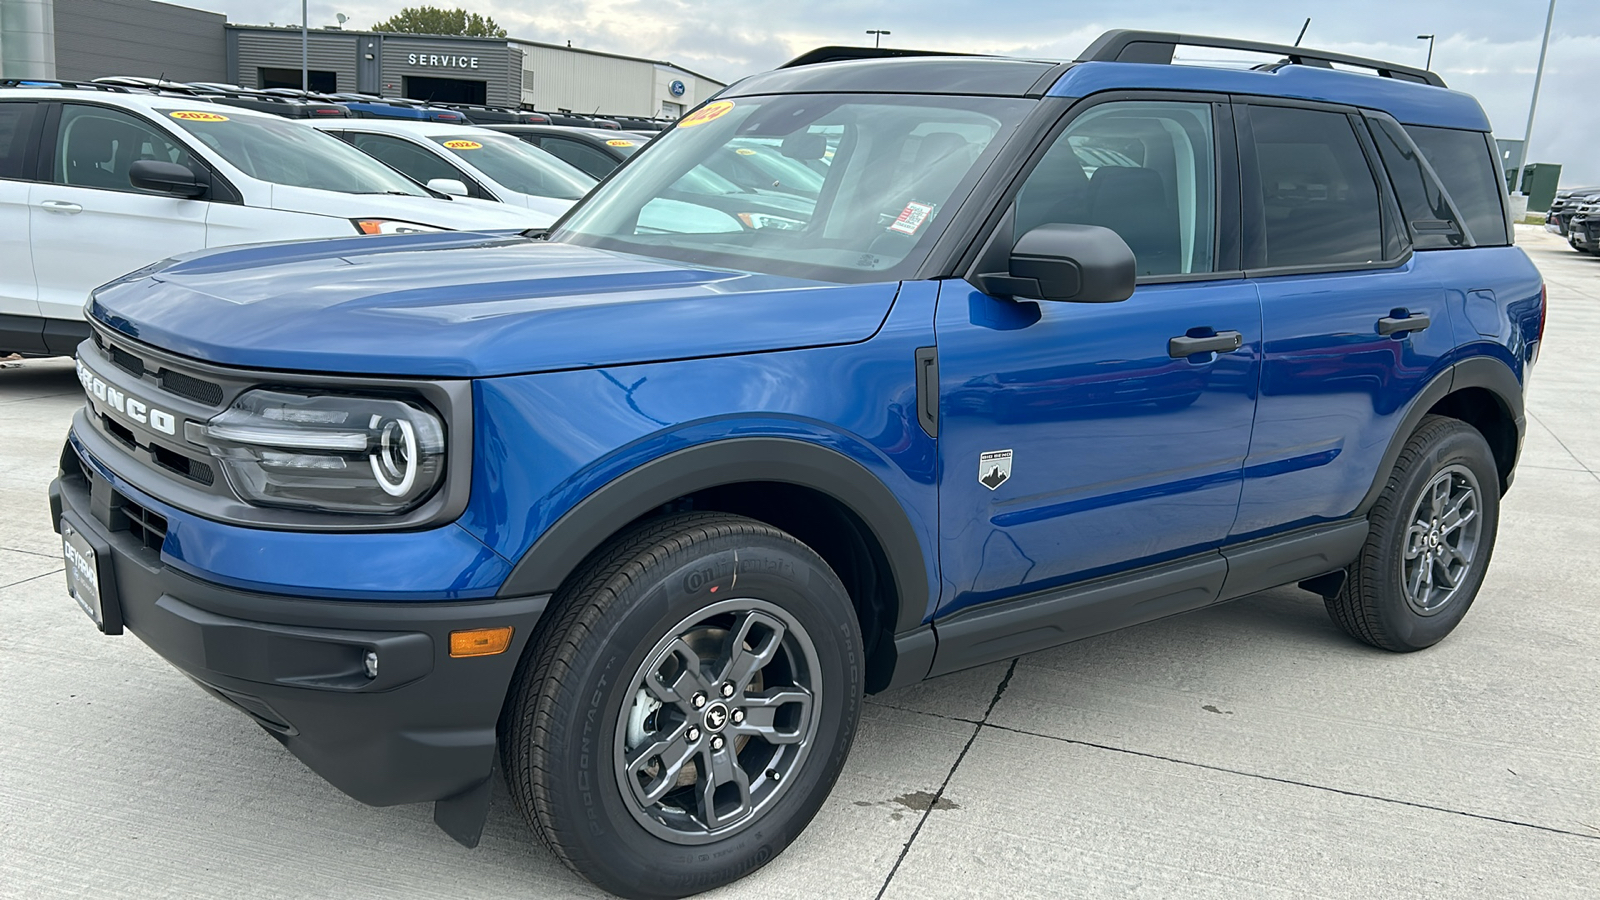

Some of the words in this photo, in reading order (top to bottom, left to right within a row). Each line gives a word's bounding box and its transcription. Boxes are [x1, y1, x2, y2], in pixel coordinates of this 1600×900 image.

[408, 53, 479, 69] SERVICE
[176, 112, 224, 120] 2024
[680, 106, 731, 124] 2024
